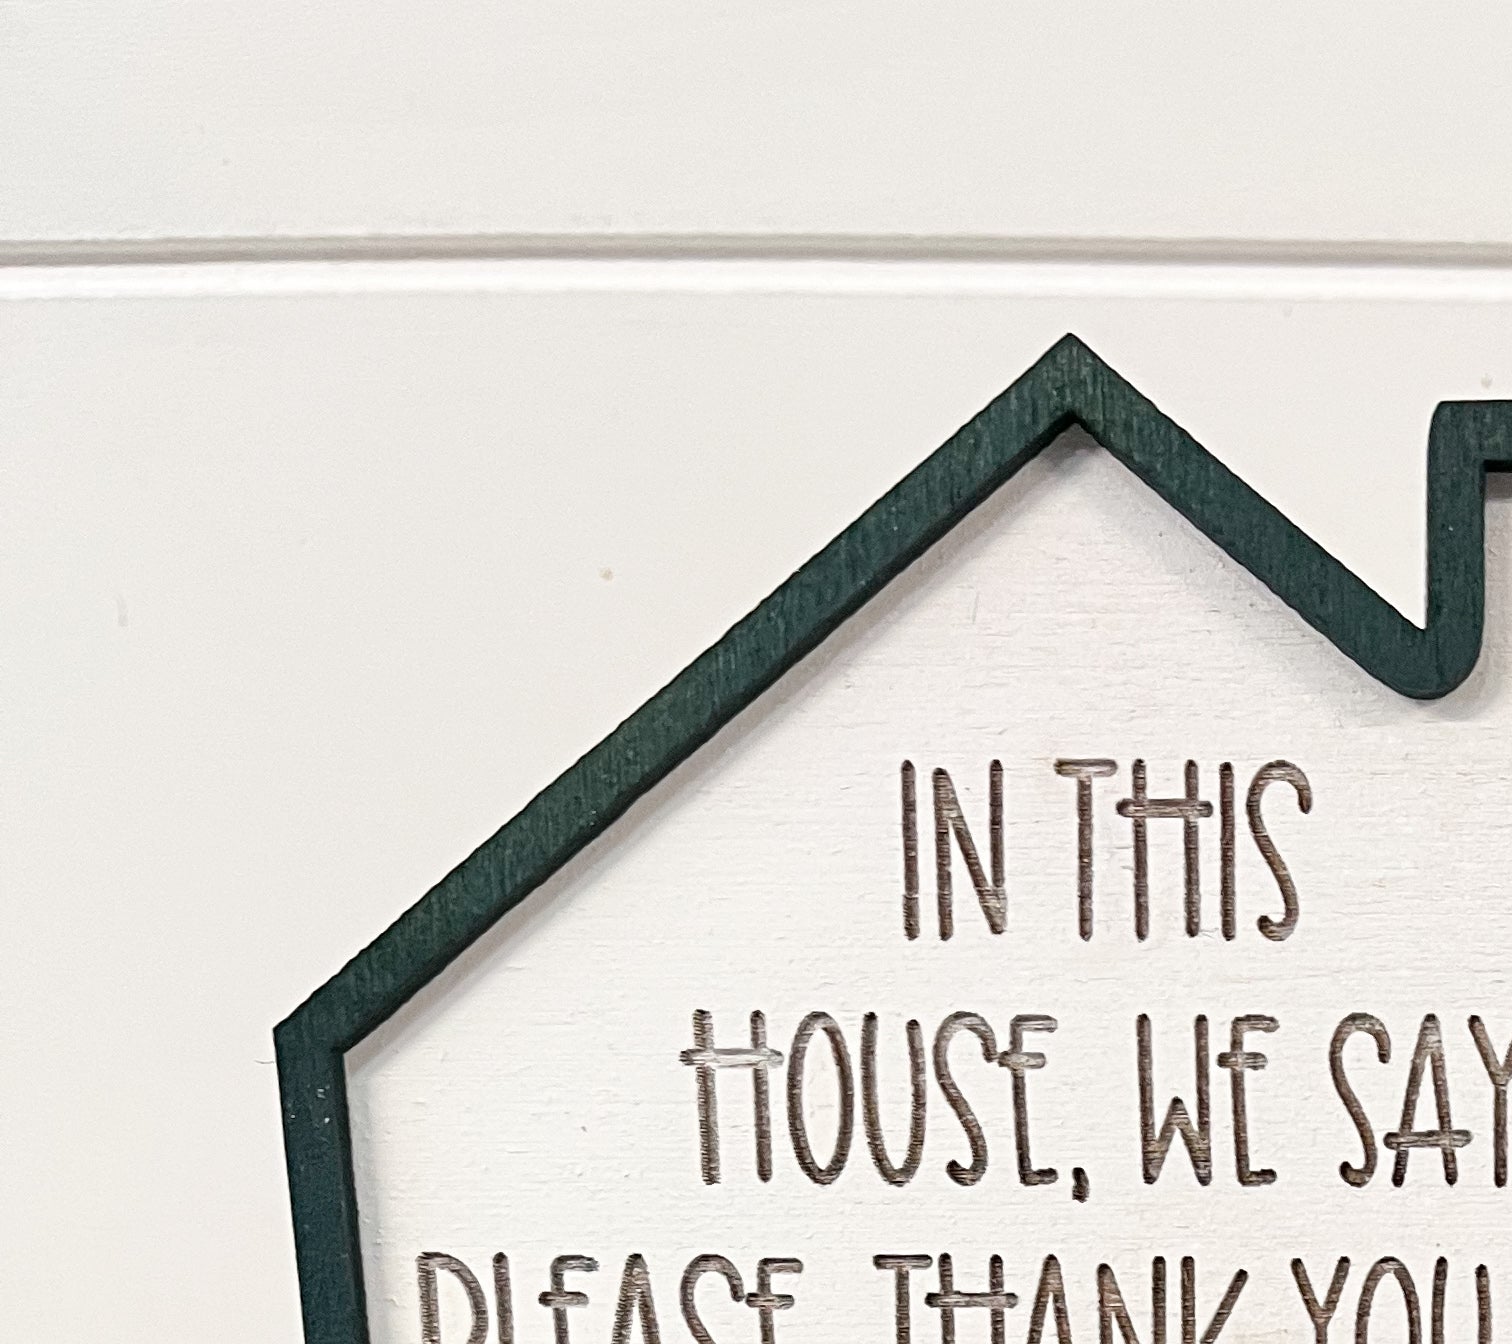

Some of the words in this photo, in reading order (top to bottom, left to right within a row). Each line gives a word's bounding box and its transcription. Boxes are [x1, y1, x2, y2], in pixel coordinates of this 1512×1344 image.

[900, 757, 1009, 943] IN
[1052, 756, 1314, 945] THIS
[678, 1007, 1091, 1204] HOUSE,
[1134, 1011, 1281, 1188] WE
